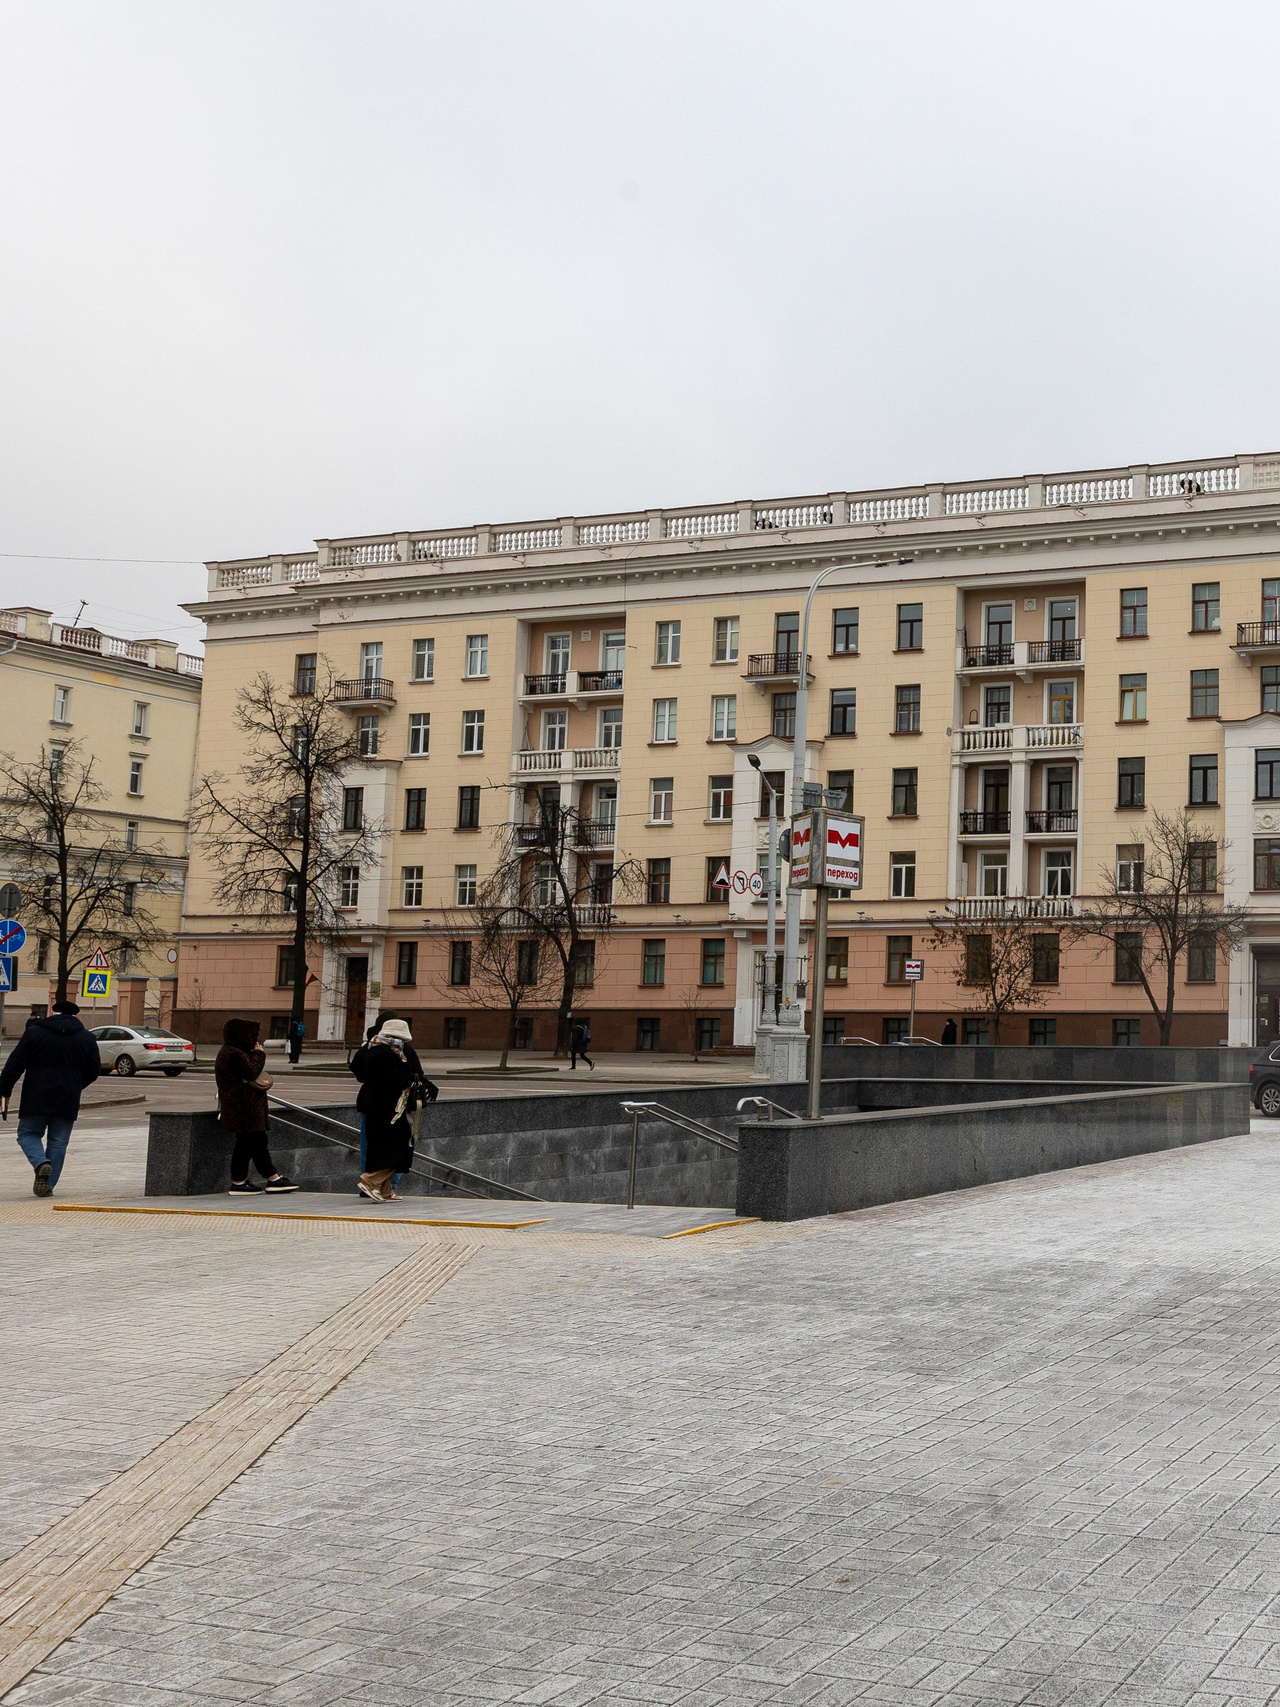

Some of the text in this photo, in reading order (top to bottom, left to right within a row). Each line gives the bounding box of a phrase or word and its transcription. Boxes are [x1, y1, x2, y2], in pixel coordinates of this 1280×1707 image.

[792, 867, 809, 880] переход
[827, 867, 858, 883] переход
[752, 880, 762, 890] 40
